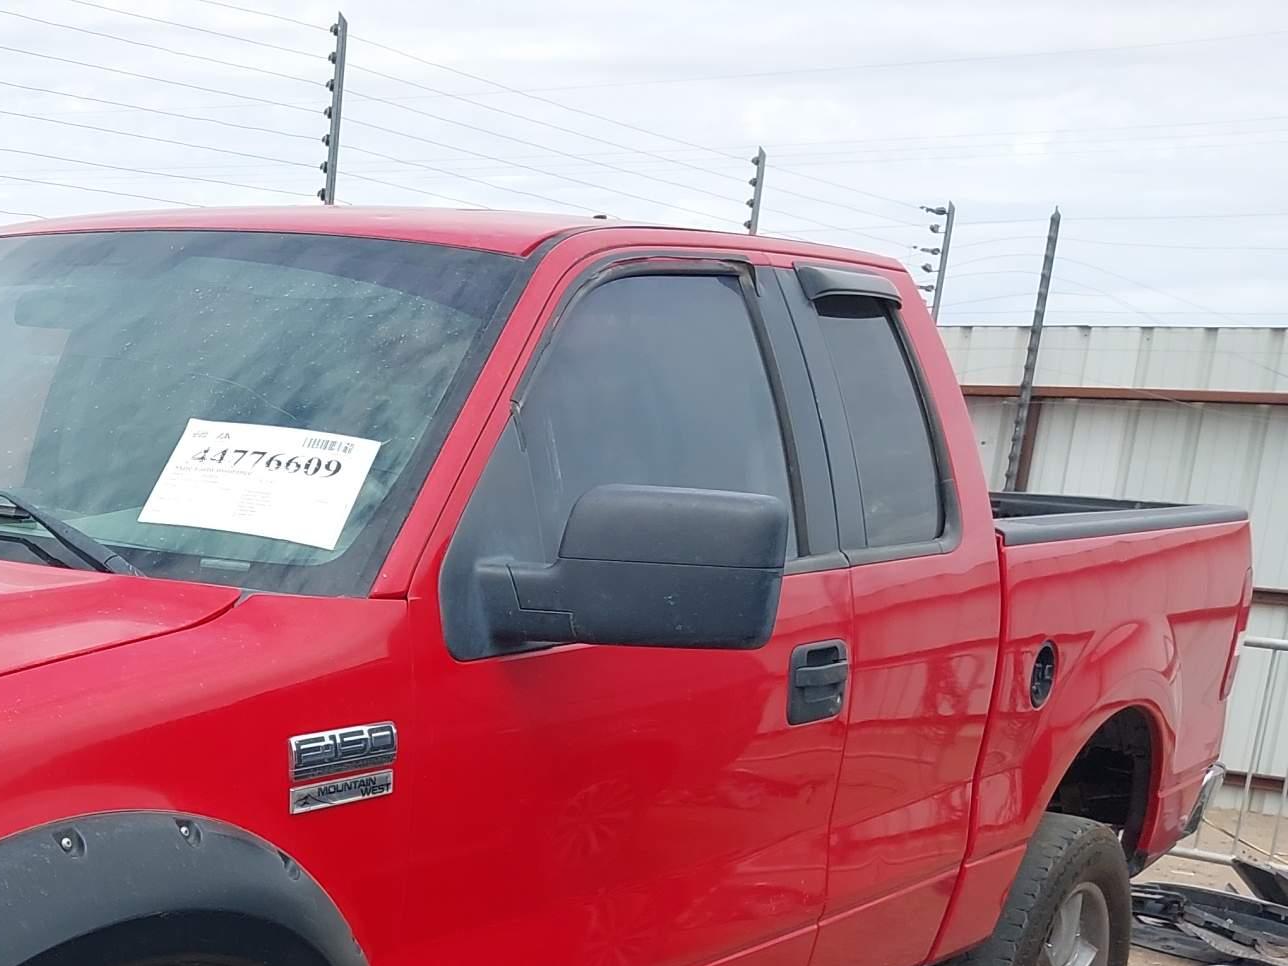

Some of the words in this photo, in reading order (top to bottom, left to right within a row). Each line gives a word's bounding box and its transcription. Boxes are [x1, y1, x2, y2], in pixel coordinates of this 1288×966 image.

[191, 446, 342, 478] 44776609
[318, 777, 377, 798] MOUNTAIN
[360, 783, 392, 797] WEST
